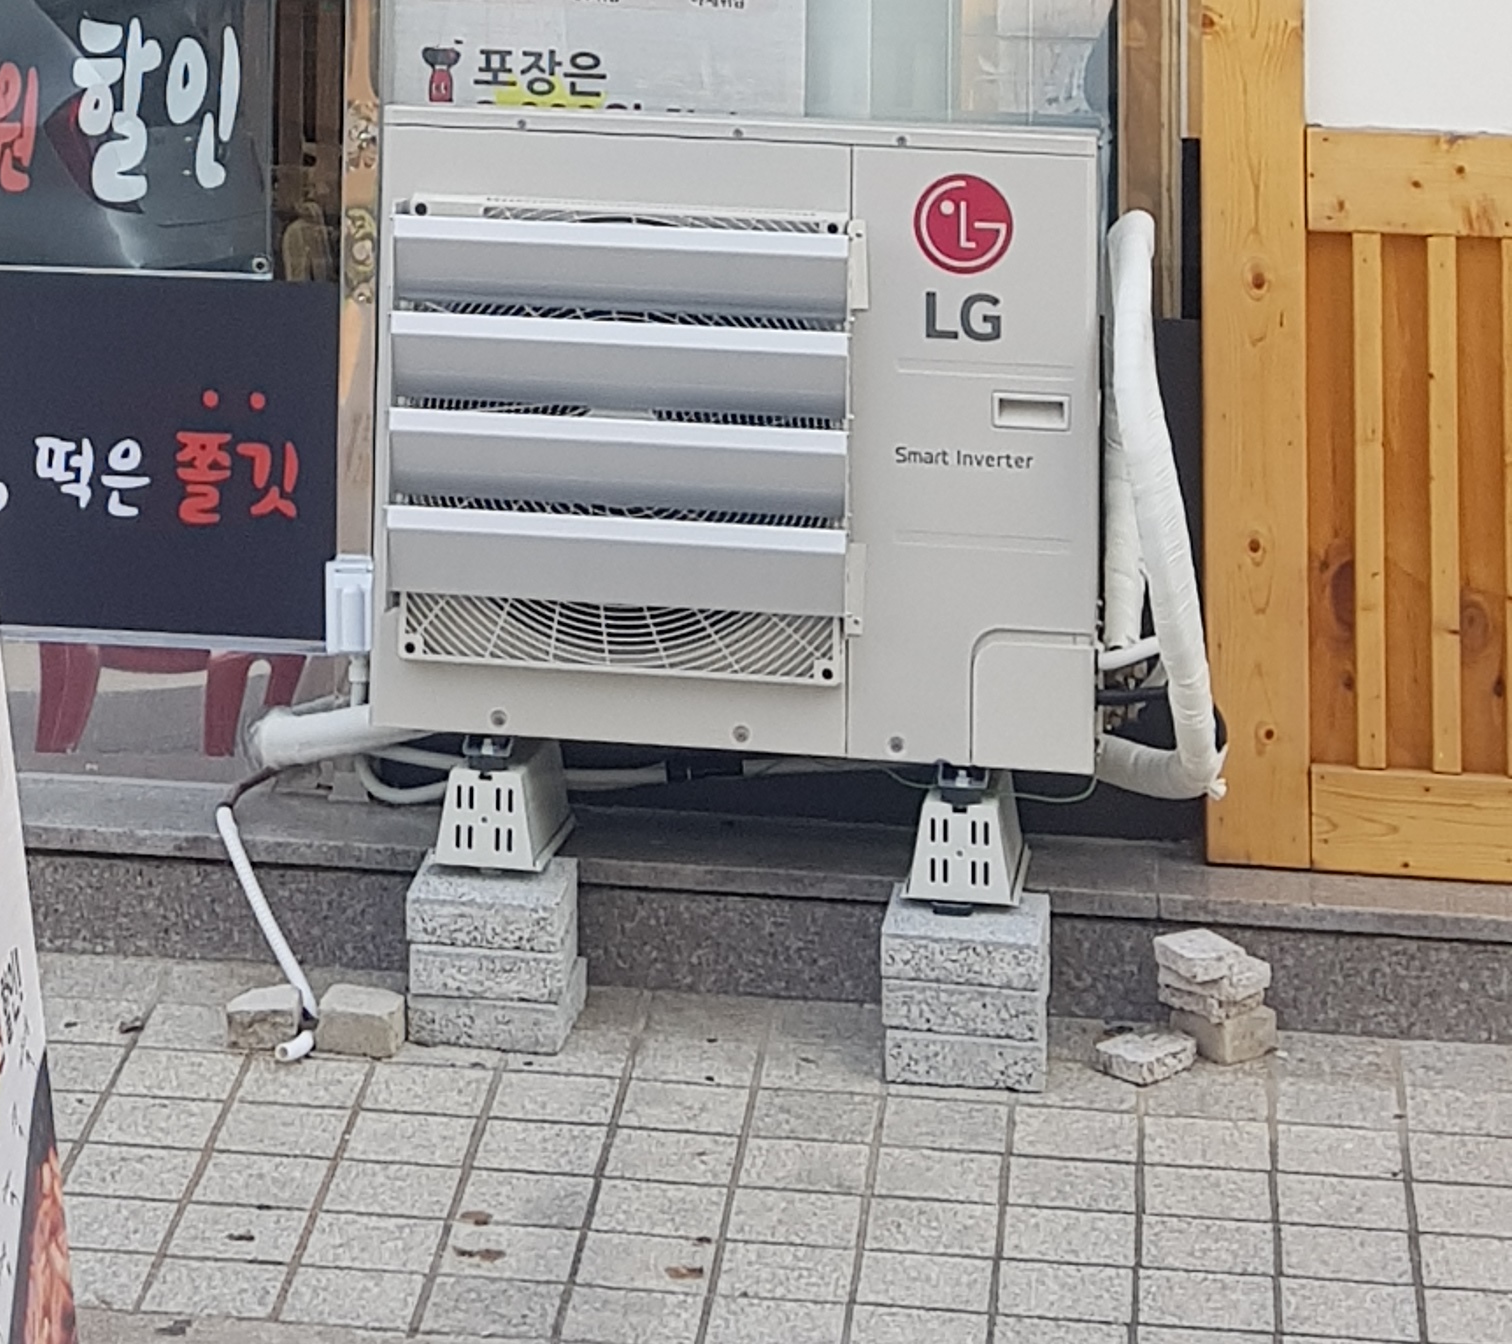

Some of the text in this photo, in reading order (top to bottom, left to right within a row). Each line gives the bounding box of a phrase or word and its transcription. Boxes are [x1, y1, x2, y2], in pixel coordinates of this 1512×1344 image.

[472, 48, 608, 97] 포장은
[72, 15, 242, 203] 할인
[925, 290, 1003, 342] LG
[34, 433, 152, 518] 떡은
[174, 429, 301, 527] 쫄깃
[894, 446, 1034, 469] Smart Inverter
